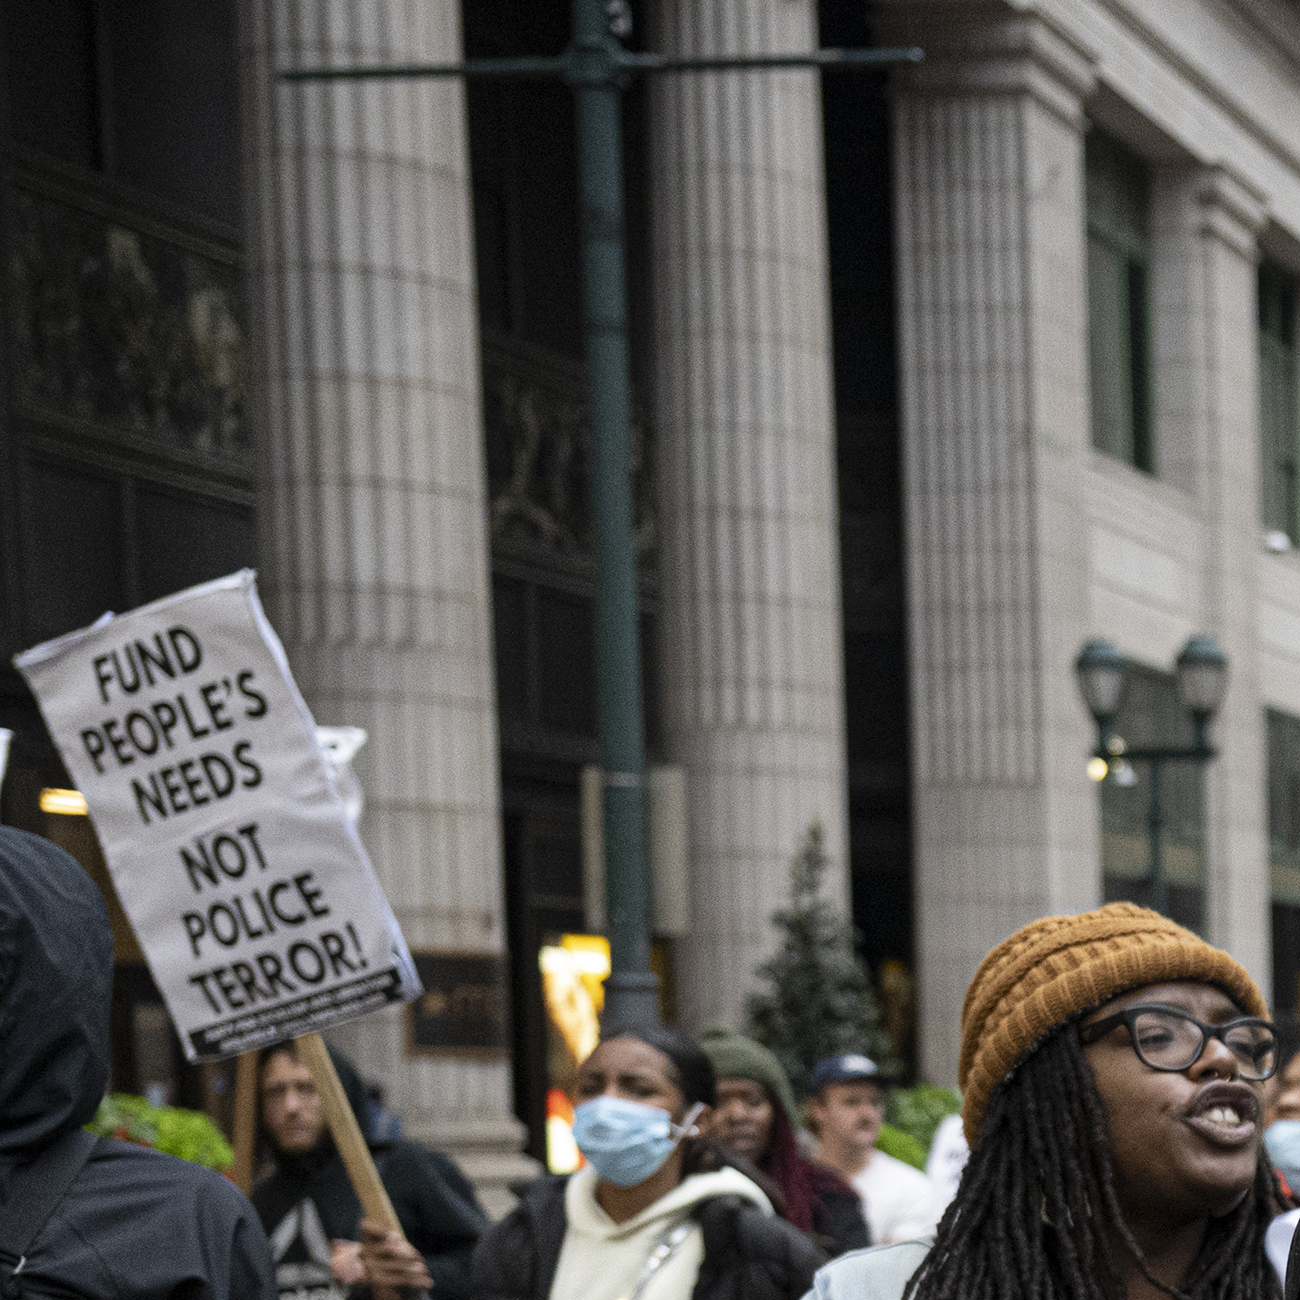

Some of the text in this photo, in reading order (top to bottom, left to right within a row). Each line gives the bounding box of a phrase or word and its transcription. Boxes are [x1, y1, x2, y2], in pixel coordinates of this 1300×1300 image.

[93, 626, 202, 703] FUND
[81, 669, 268, 777] PEOPLE'S
[130, 742, 263, 827] NEEDS
[179, 822, 268, 895] NOT
[182, 870, 331, 958] POLICE
[189, 920, 368, 1017] TERROR!
